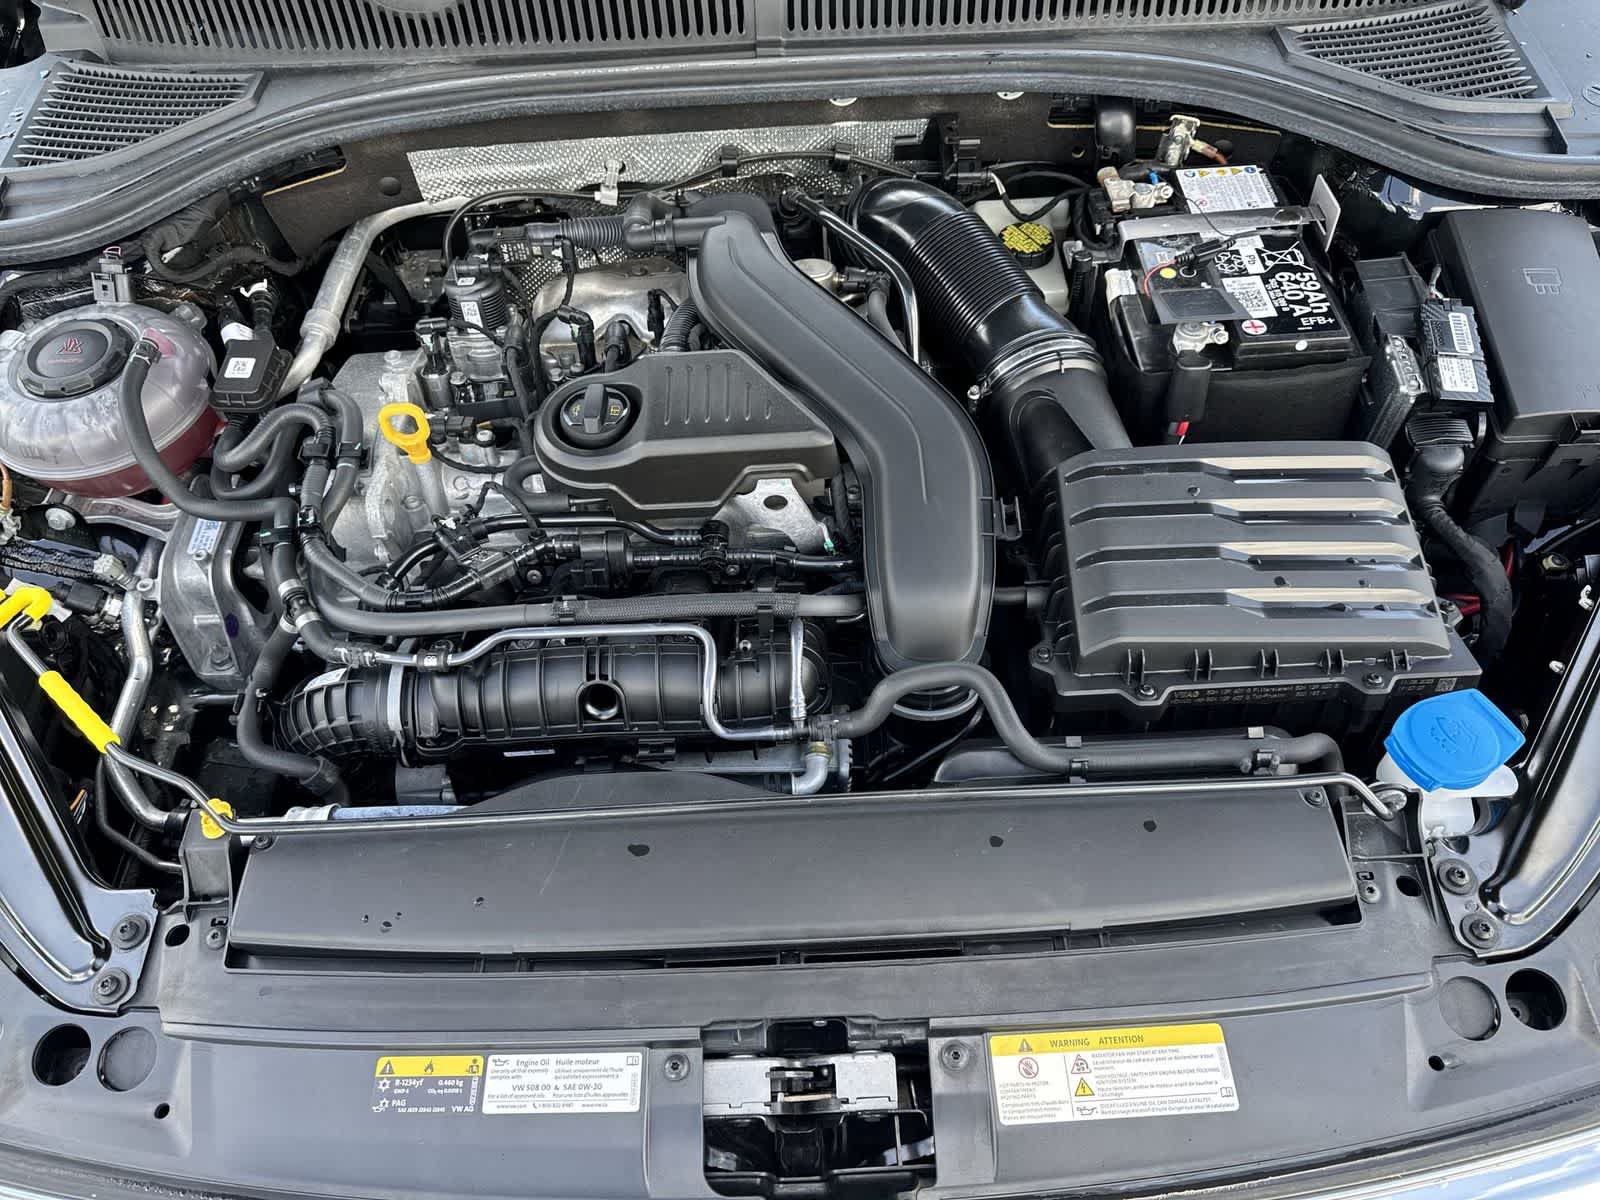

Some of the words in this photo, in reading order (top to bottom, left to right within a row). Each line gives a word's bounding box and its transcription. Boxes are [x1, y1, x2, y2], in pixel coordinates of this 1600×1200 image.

[1275, 271, 1305, 300] 640
[1295, 272, 1331, 313] 59Ah
[1289, 304, 1312, 317] A
[1300, 316, 1335, 326] EFB+
[1049, 1038, 1090, 1049] WARNING
[1098, 1034, 1145, 1046] ATTENTION
[516, 1058, 539, 1068] Engine
[540, 1058, 550, 1066] Oil
[555, 1057, 574, 1066] Huile
[575, 1058, 600, 1066] moteur
[512, 1083, 525, 1091] VW
[526, 1083, 539, 1091] 508
[540, 1083, 551, 1091] 00
[578, 1082, 603, 1090] 0W-20
[391, 1099, 407, 1107] PAG
